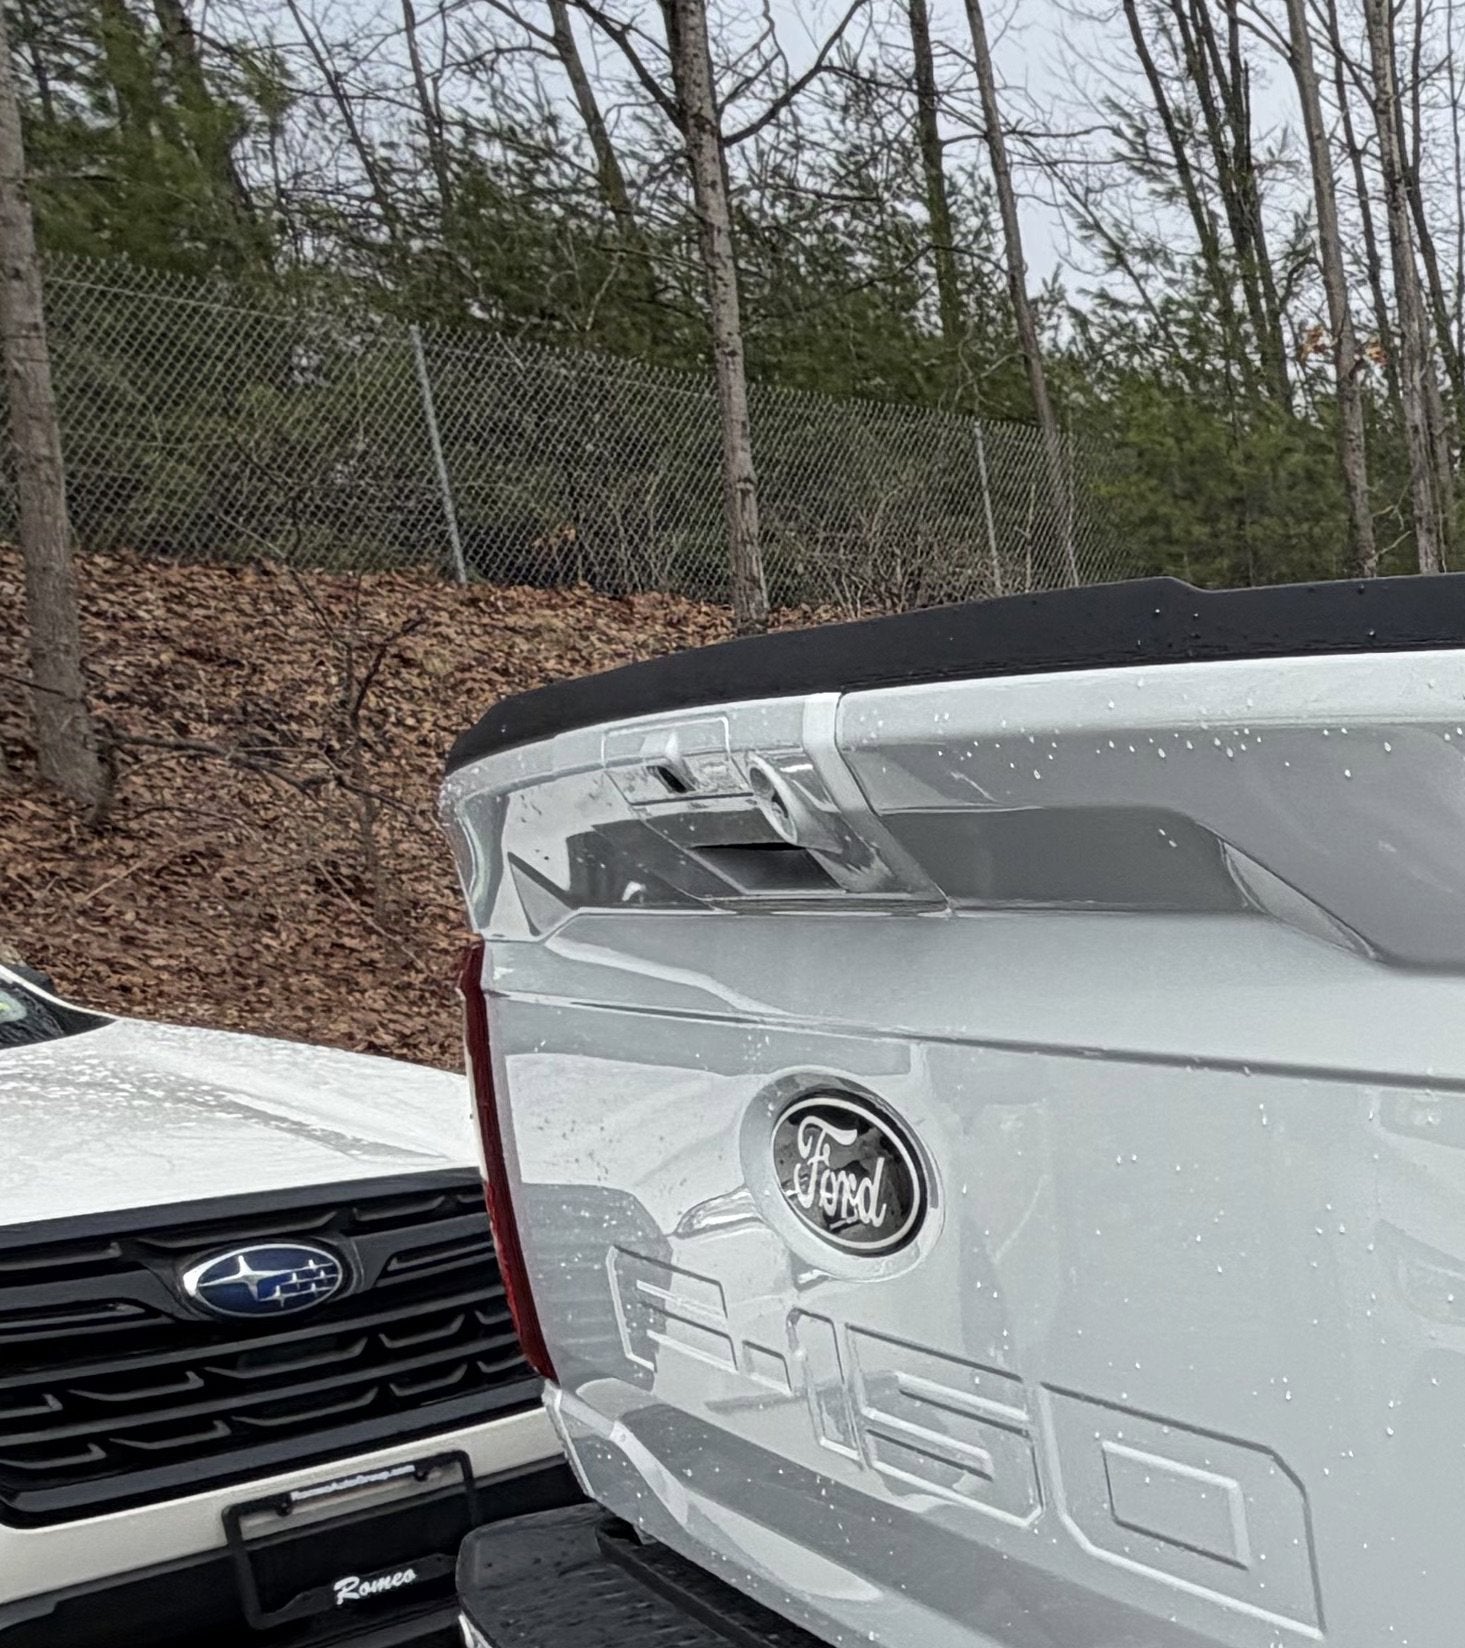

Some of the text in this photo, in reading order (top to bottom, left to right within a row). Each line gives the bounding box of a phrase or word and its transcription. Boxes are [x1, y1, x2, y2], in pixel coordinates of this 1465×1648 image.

[793, 1115, 887, 1228] Ford
[606, 1243, 1327, 1641] F-150
[333, 1568, 417, 1605] Romeo
